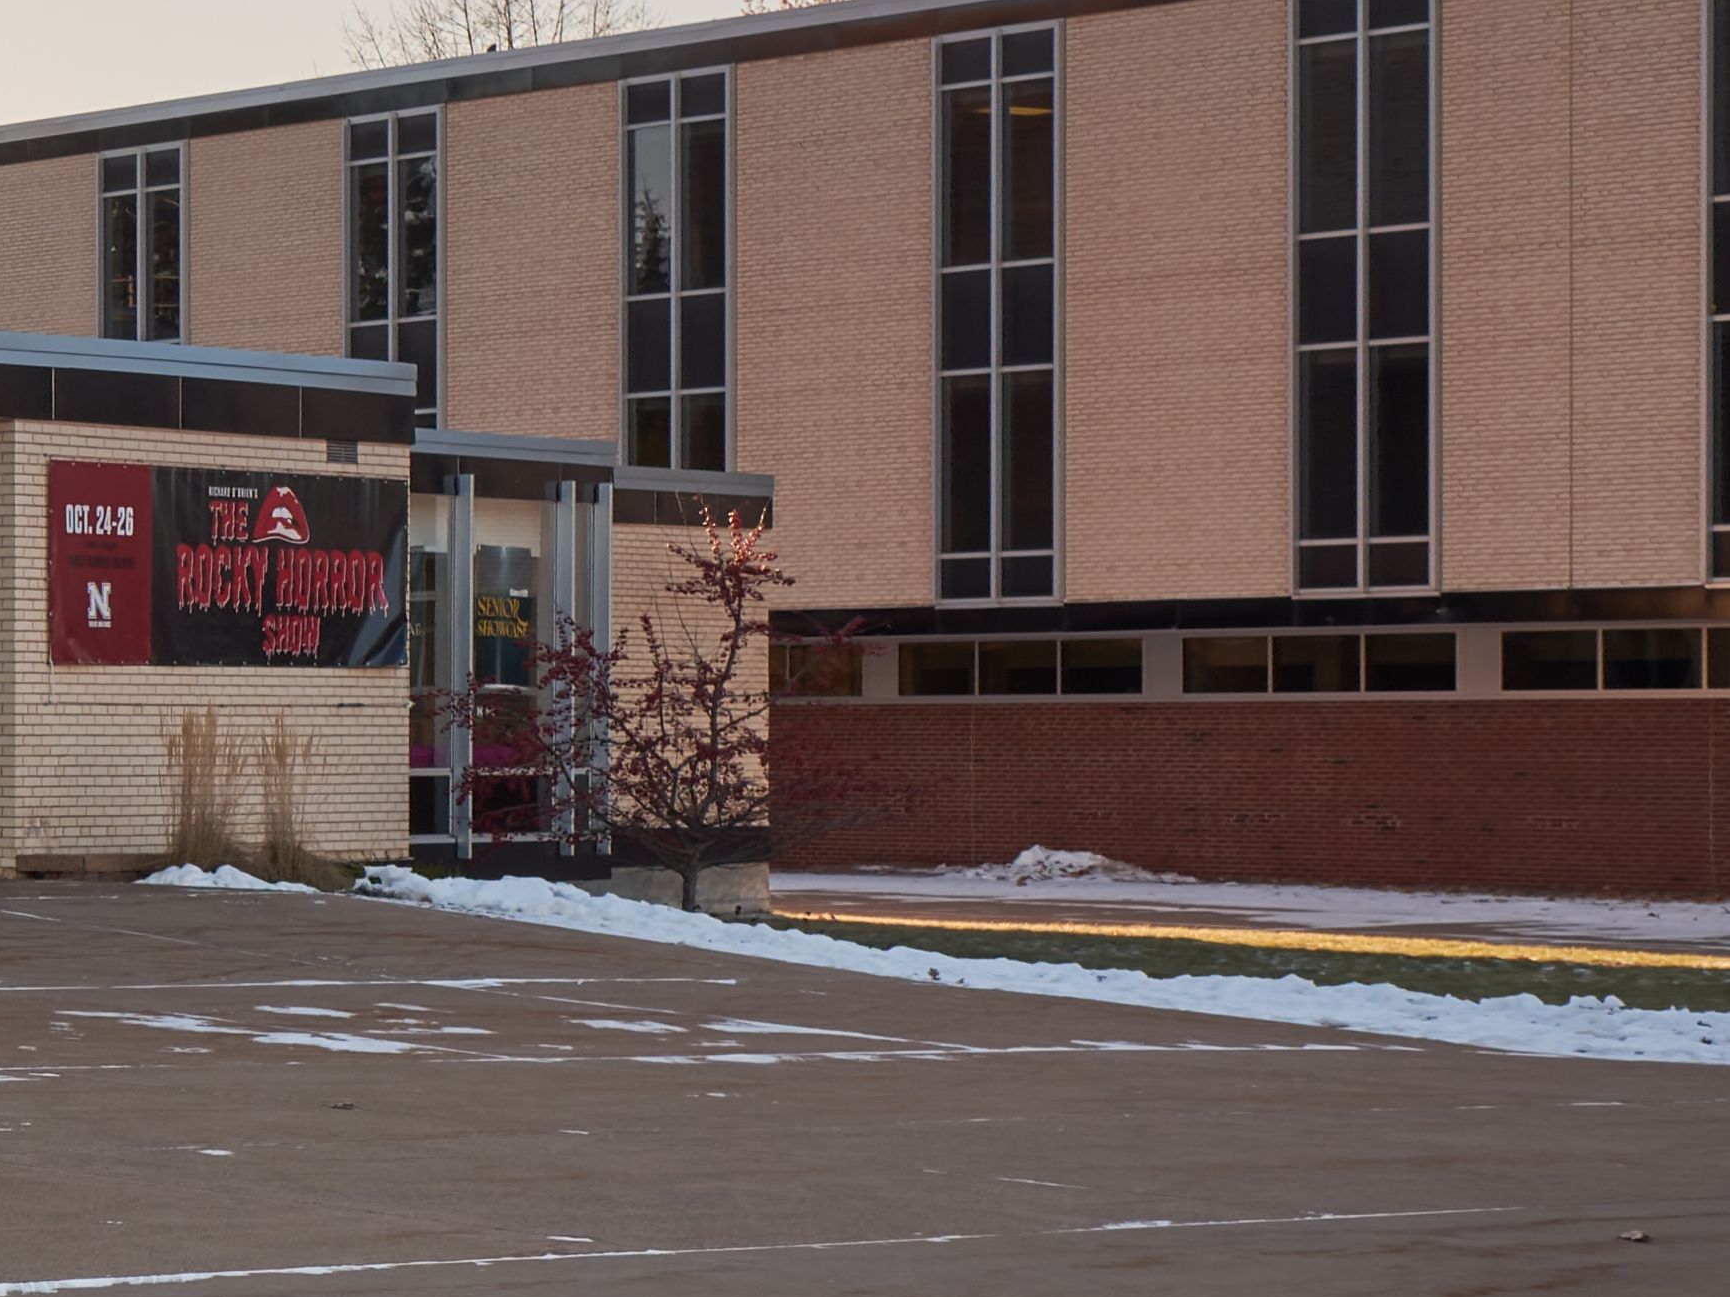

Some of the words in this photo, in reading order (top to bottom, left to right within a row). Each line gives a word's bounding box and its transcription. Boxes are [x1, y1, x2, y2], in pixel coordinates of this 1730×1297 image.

[66, 504, 92, 534] OCT.
[96, 505, 134, 536] 24-26
[209, 500, 249, 545] THE
[87, 581, 111, 620] N
[176, 544, 269, 617] ROCKY
[276, 547, 389, 618] HORROR
[478, 596, 527, 625] SENIOR
[263, 614, 320, 661] SHOW
